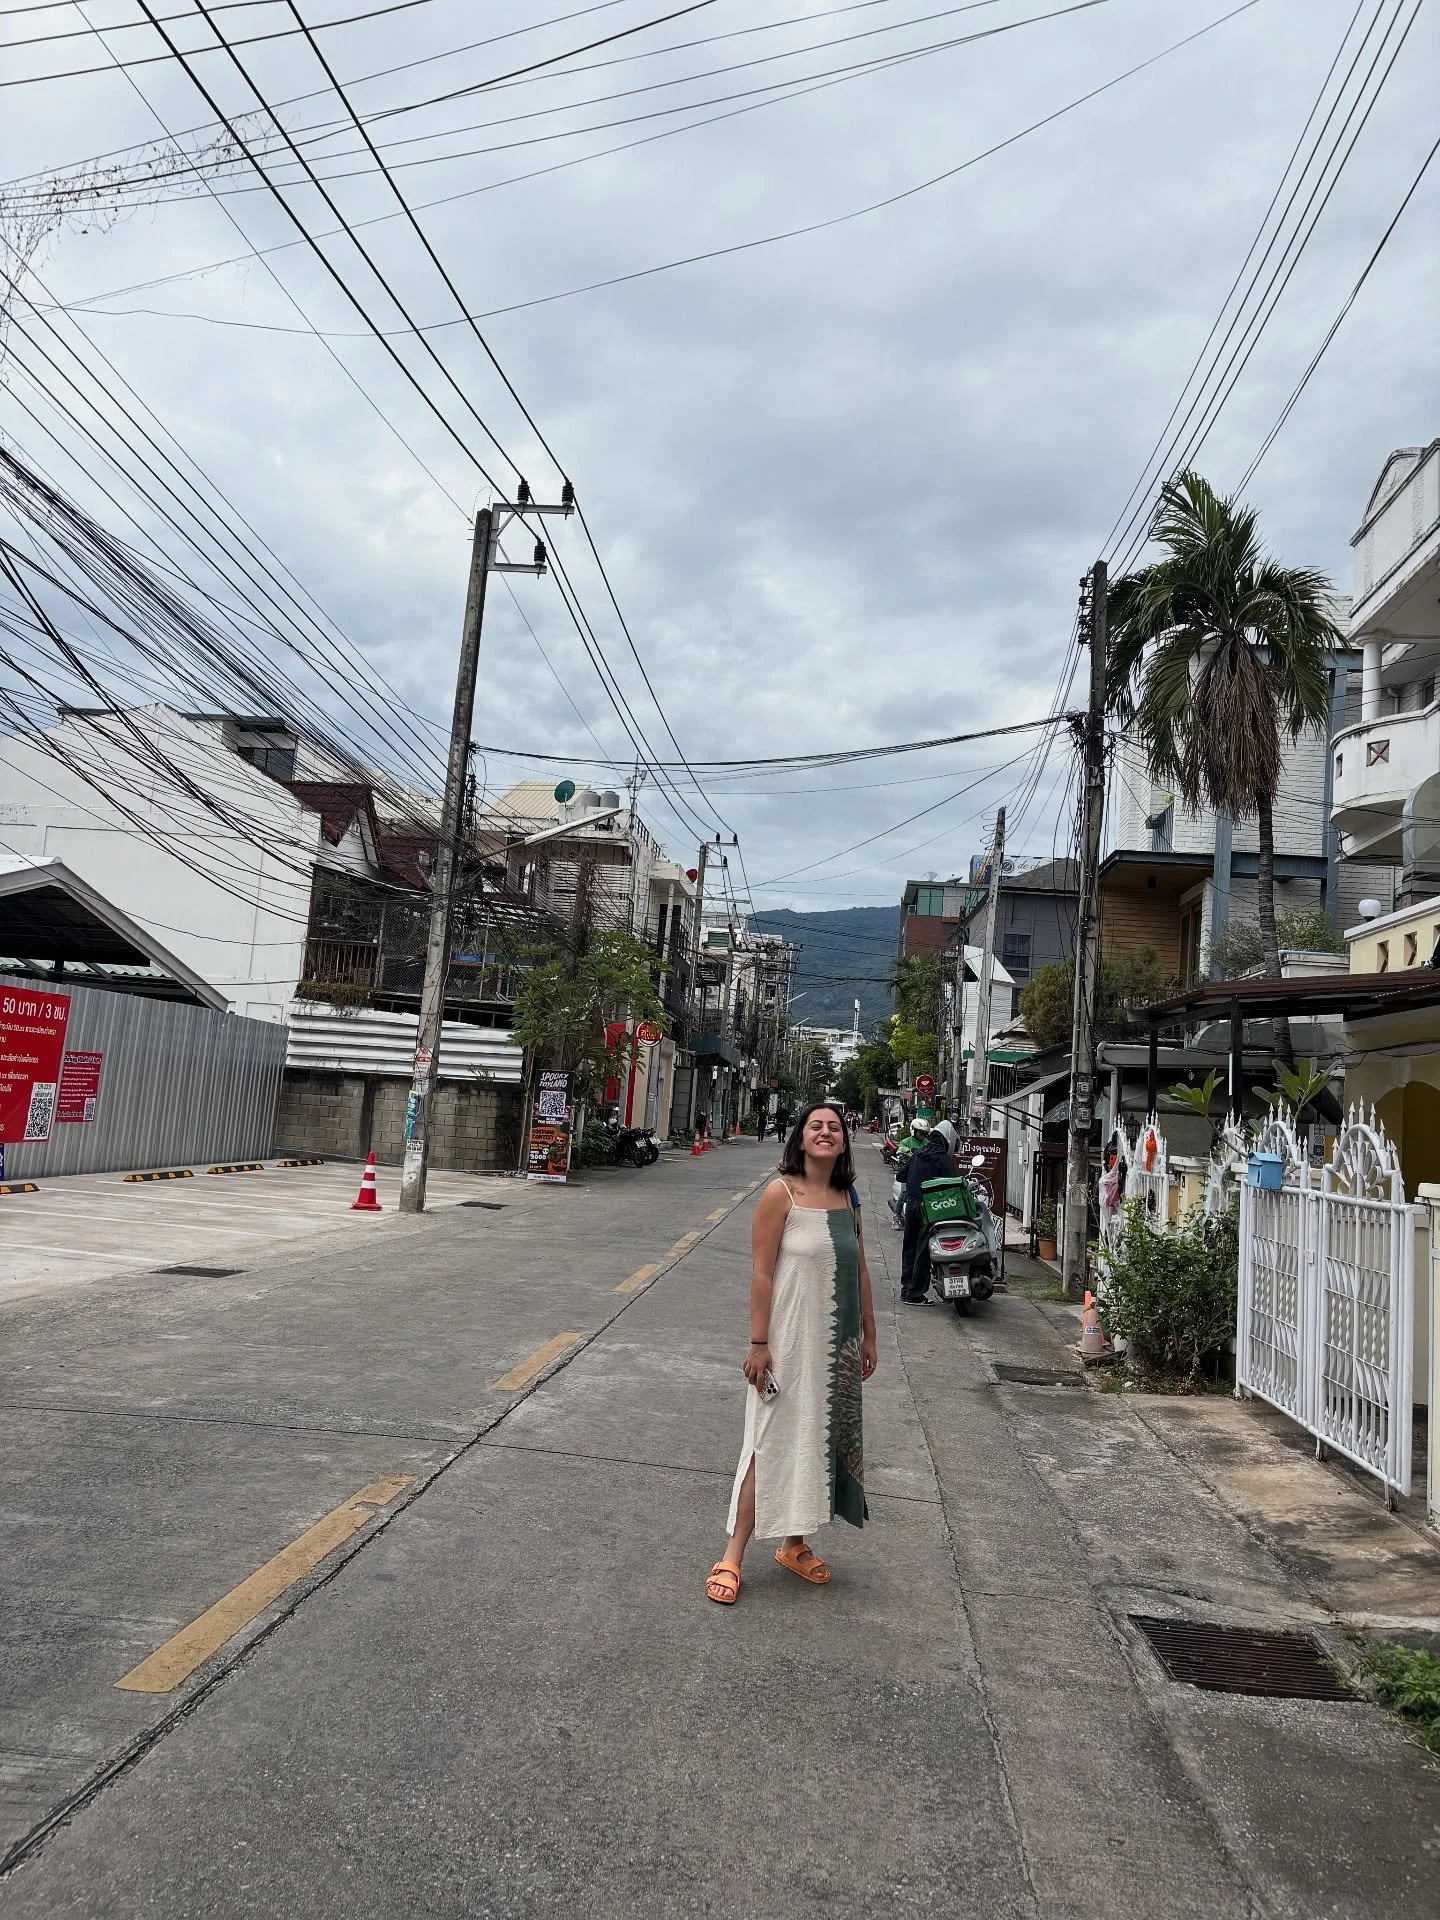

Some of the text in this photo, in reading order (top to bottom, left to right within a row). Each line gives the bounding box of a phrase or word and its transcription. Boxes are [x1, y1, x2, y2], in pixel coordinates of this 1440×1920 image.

[3, 997, 16, 1013] 50
[18, 1001, 37, 1016] บาท
[38, 1002, 44, 1018] /
[45, 1003, 52, 1018] 3
[541, 1072, 569, 1081] SPOOKY
[539, 1080, 568, 1088] TOYLAND
[930, 1198, 957, 1211] Grab
